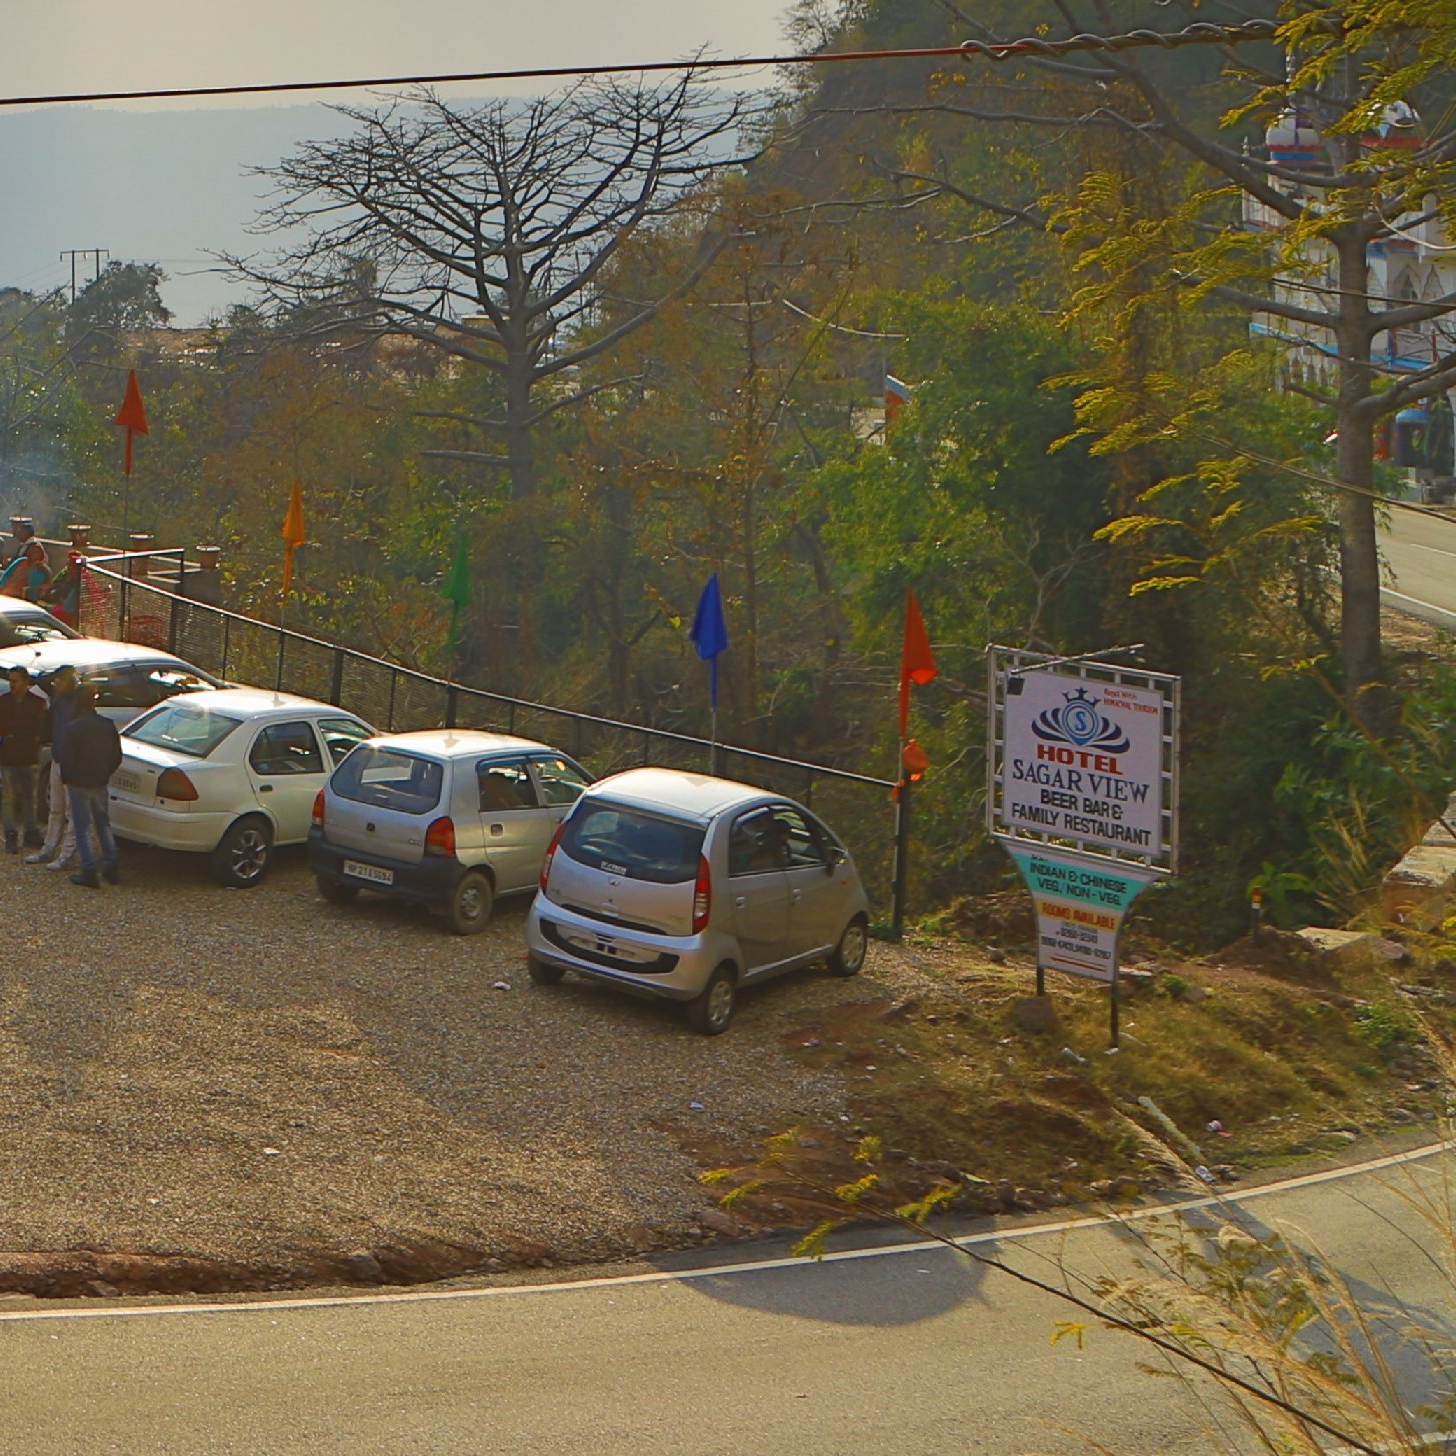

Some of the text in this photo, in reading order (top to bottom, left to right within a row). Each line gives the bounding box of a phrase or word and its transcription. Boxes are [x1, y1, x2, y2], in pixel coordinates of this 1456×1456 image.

[1037, 744, 1124, 775] HOTEL
[1013, 759, 1150, 804] SAGAR VIEW
[1041, 789, 1079, 811] BEER
[1012, 802, 1151, 846] FAMILY RESTAURANT
[1030, 862, 1127, 894] INDIAN & CHINESE
[1043, 902, 1071, 920] ROOMS
[1073, 910, 1115, 930] AVAILABLE
